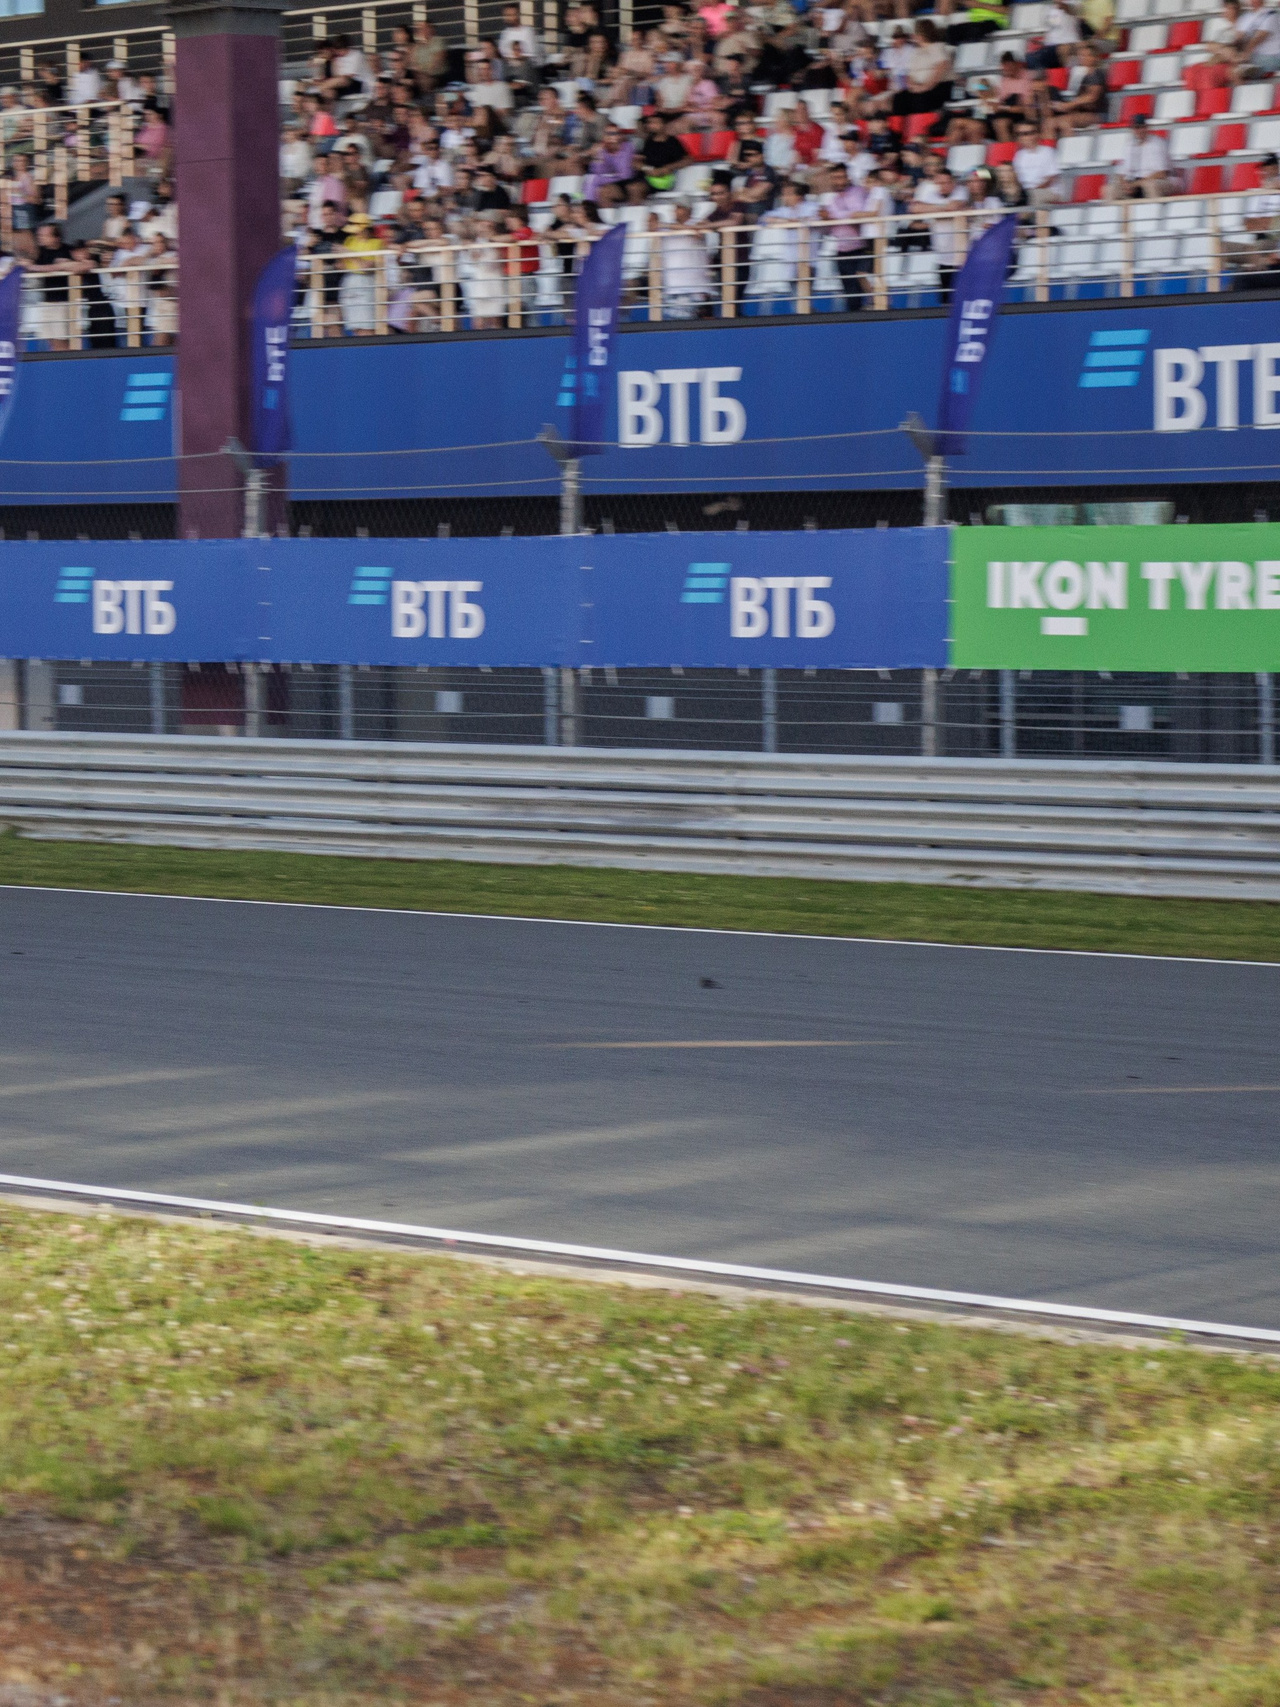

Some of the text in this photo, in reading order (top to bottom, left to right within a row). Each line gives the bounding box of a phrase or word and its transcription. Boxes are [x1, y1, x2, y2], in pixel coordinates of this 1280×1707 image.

[955, 299, 993, 362] ВТБ
[617, 366, 747, 448] ВТБ
[93, 580, 177, 635] ВТБ
[391, 580, 486, 639] ВТБ
[730, 576, 836, 638] ВТБ
[986, 560, 1280, 610] IKON TYRE
